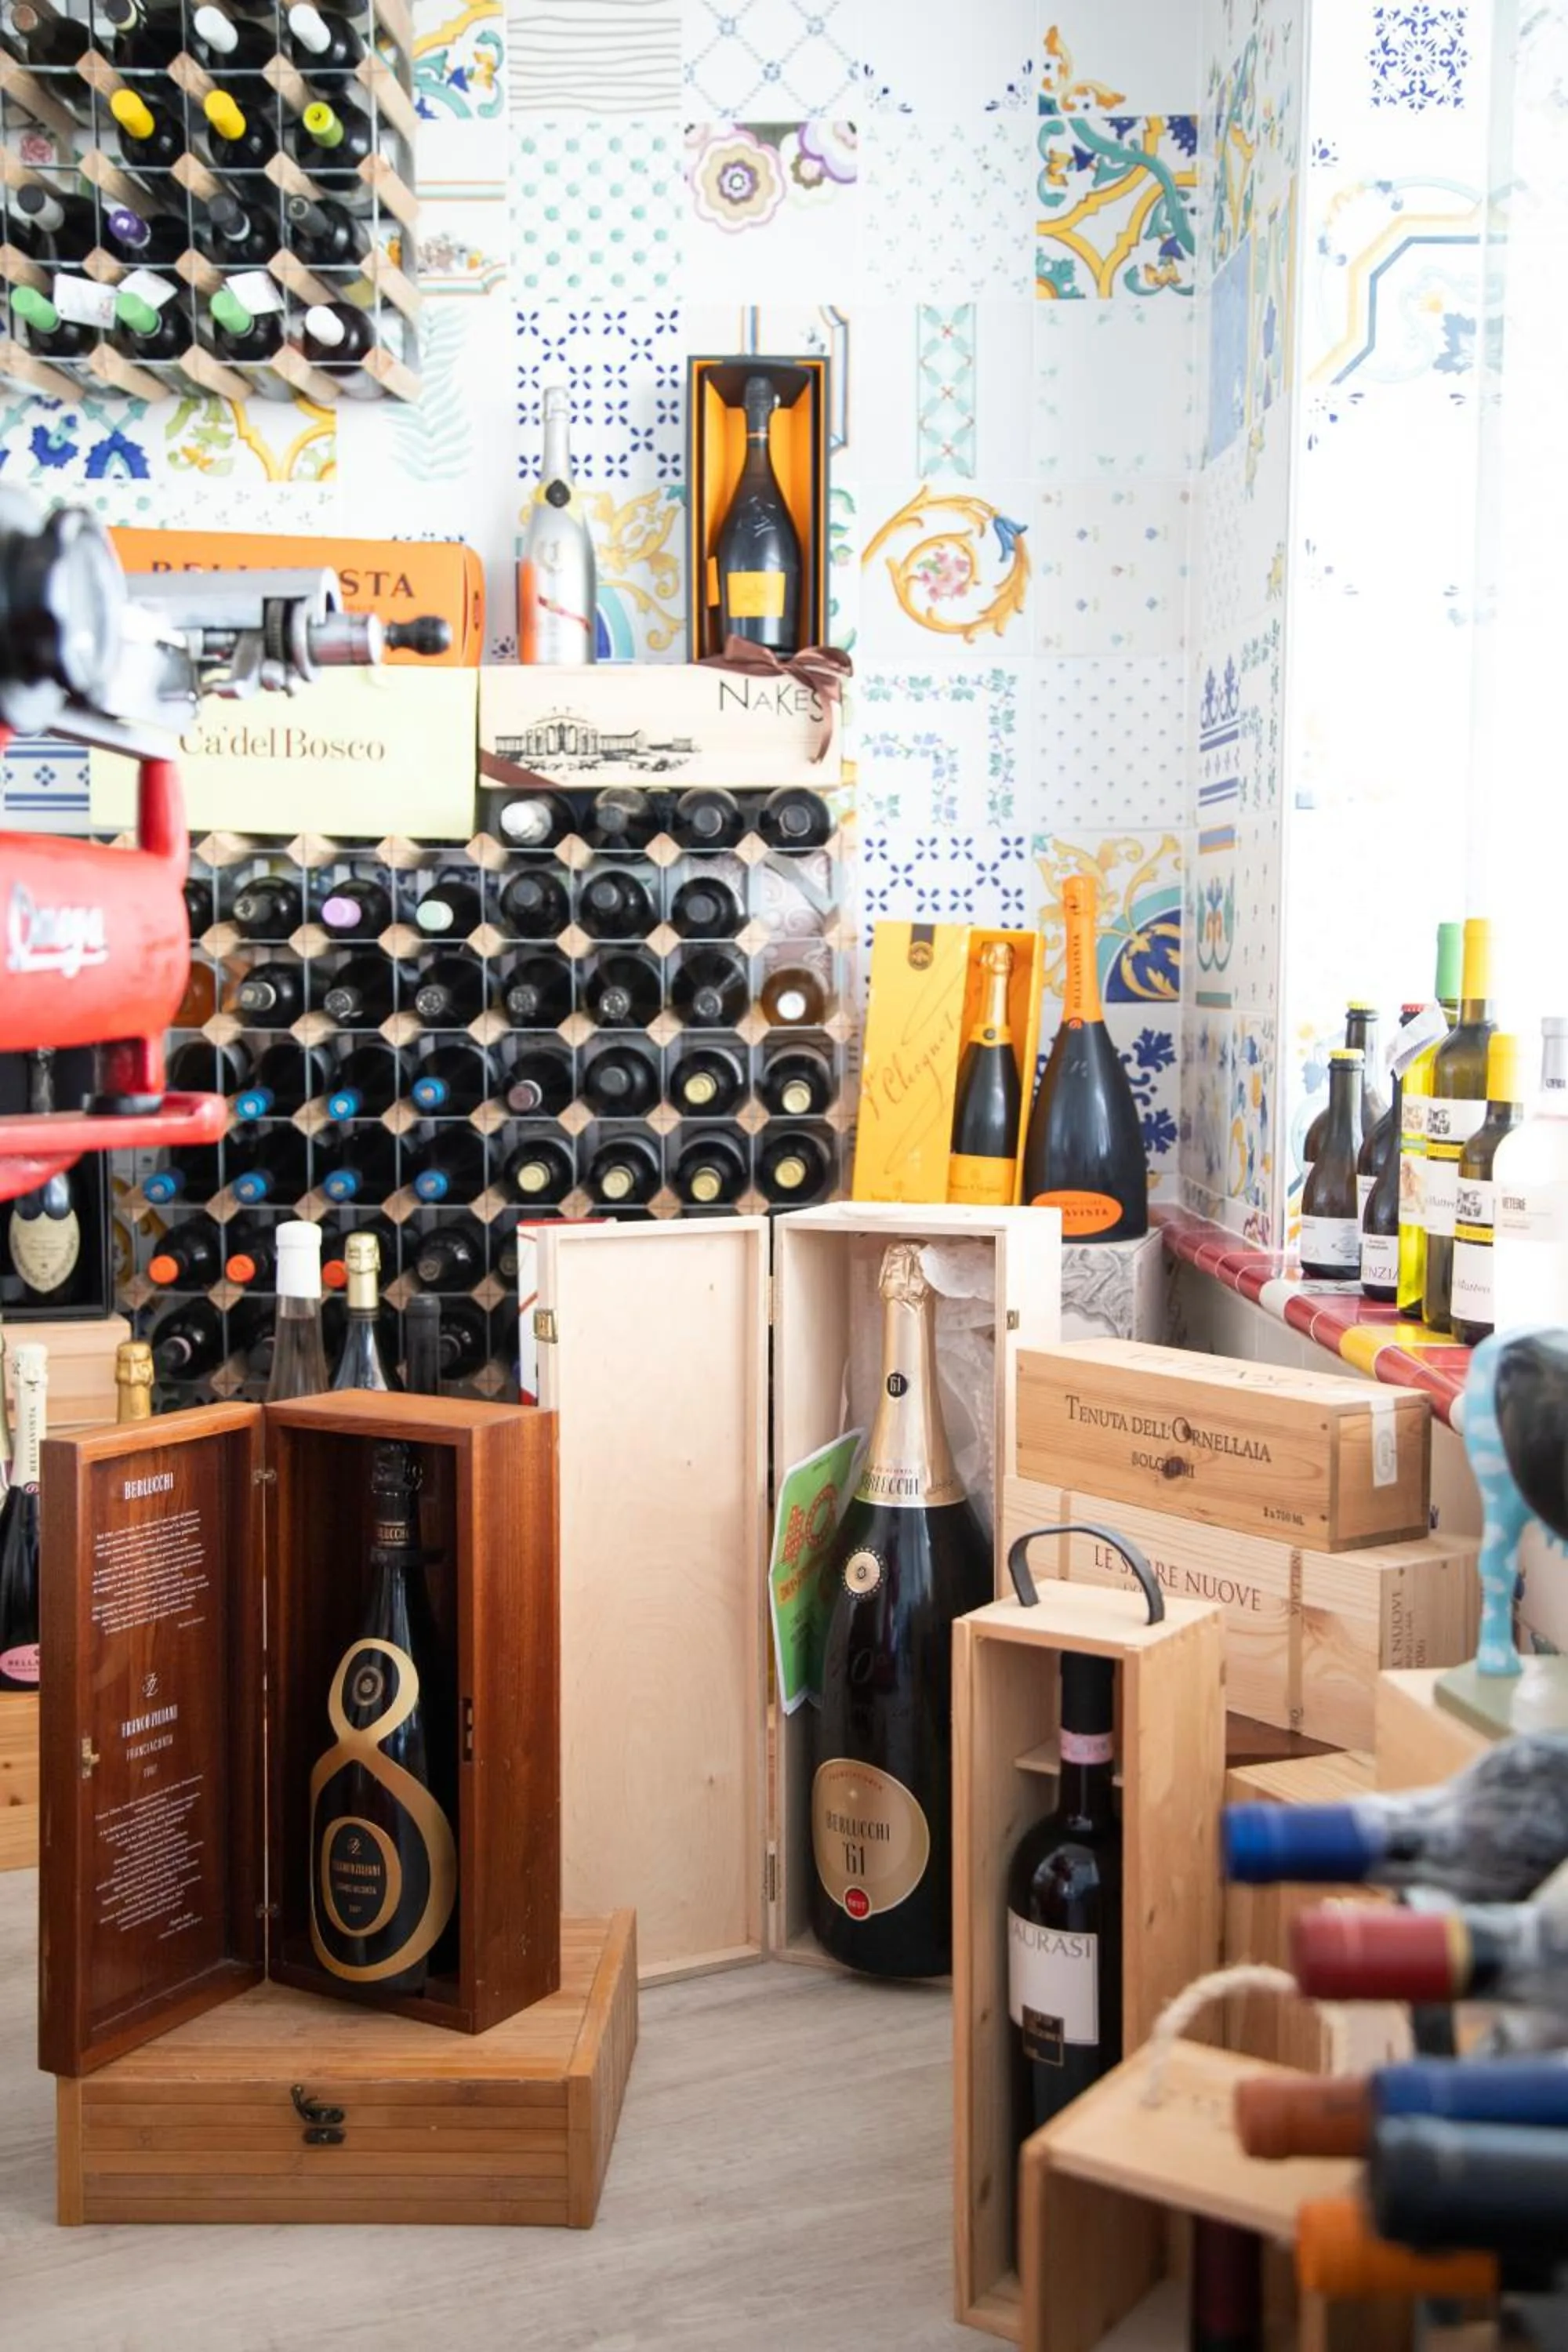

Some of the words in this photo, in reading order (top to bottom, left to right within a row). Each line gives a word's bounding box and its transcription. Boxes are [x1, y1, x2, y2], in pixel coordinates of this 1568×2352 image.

[285, 728, 386, 761] Bosco
[1065, 1207, 1109, 1218] AVISTA
[1065, 1395, 1129, 1432] TENUTA
[1131, 1416, 1272, 1463] DELL'ORNELLAIA
[1131, 1450, 1195, 1479] BOLGRI
[125, 1471, 174, 1500] BERLUCCHI
[1094, 1544, 1113, 1570] LE
[1120, 1554, 1178, 1589] SRE
[1185, 1570, 1261, 1611] NUOVE
[826, 1809, 891, 1842] BERLUCCHI
[1014, 1921, 1094, 1959] AURASI
